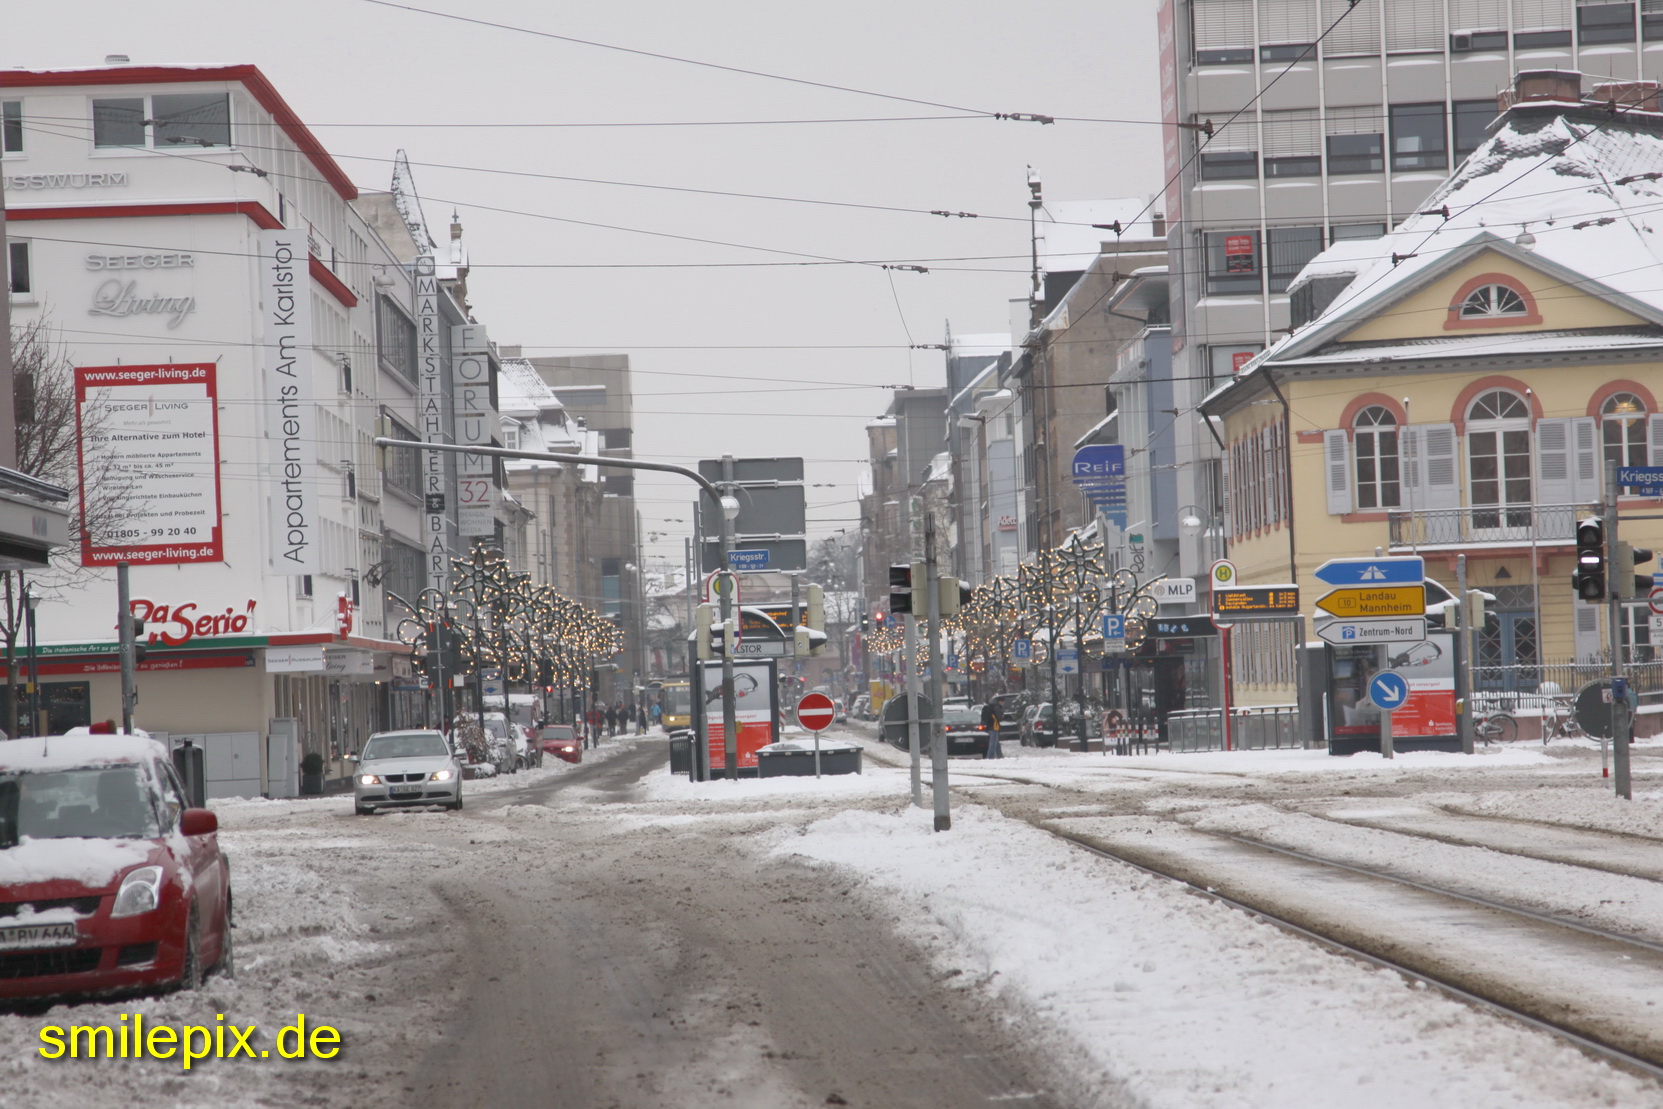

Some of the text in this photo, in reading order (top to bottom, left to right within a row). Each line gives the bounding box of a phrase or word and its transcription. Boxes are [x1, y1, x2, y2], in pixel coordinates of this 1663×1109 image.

[3, 173, 128, 190] USSWURM
[86, 254, 194, 271] SEEGER
[88, 279, 196, 330] Living
[84, 368, 206, 382] www.seeger-living.de
[419, 279, 439, 492] MARKSTAHLER
[272, 240, 308, 564] Appartements Am Karlstor
[460, 329, 490, 502] FORUM 32
[111, 433, 159, 441] Alternative
[107, 530, 139, 538] 01805
[92, 547, 213, 560] www.seeger-living.de
[730, 553, 766, 562] Kriegsstr.
[1168, 585, 1192, 595] MLP
[1360, 592, 1396, 601] Landau
[1360, 603, 1412, 612] Mannheim
[1360, 626, 1412, 636] Zentrum-Nord
[736, 645, 762, 653] LSTOR
[18, 929, 37, 941] BV
